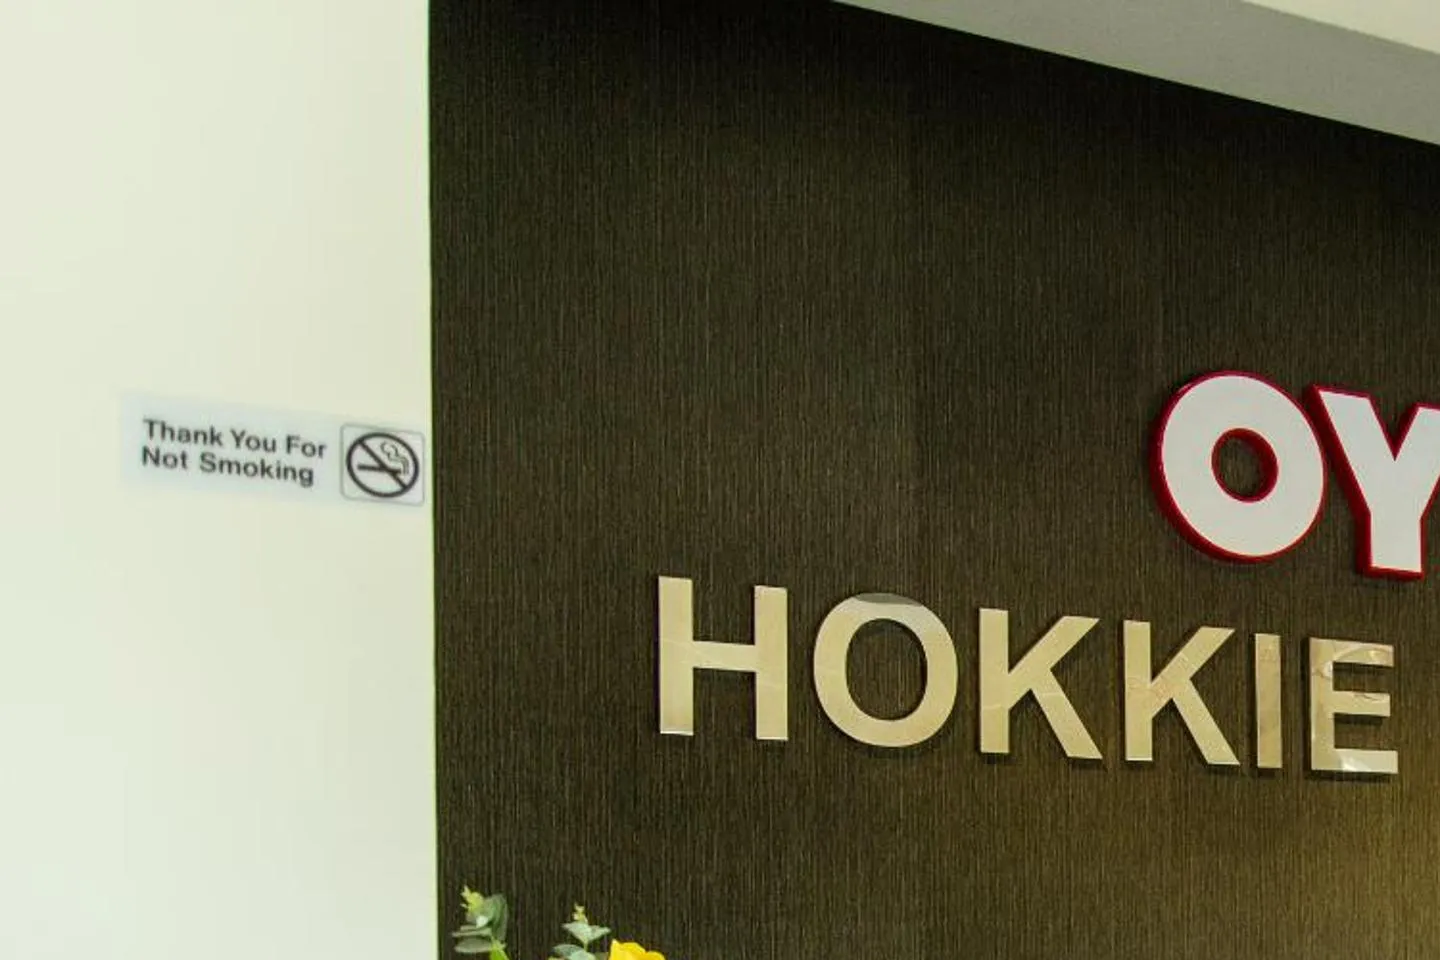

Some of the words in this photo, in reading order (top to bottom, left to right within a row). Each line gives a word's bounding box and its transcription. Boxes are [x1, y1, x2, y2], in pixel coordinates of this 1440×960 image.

[143, 418, 223, 447] Thank
[230, 428, 278, 454] You
[286, 434, 328, 459] For
[141, 444, 189, 470] Not
[200, 452, 314, 487] Smoking
[657, 574, 1400, 775] HOKKIE
